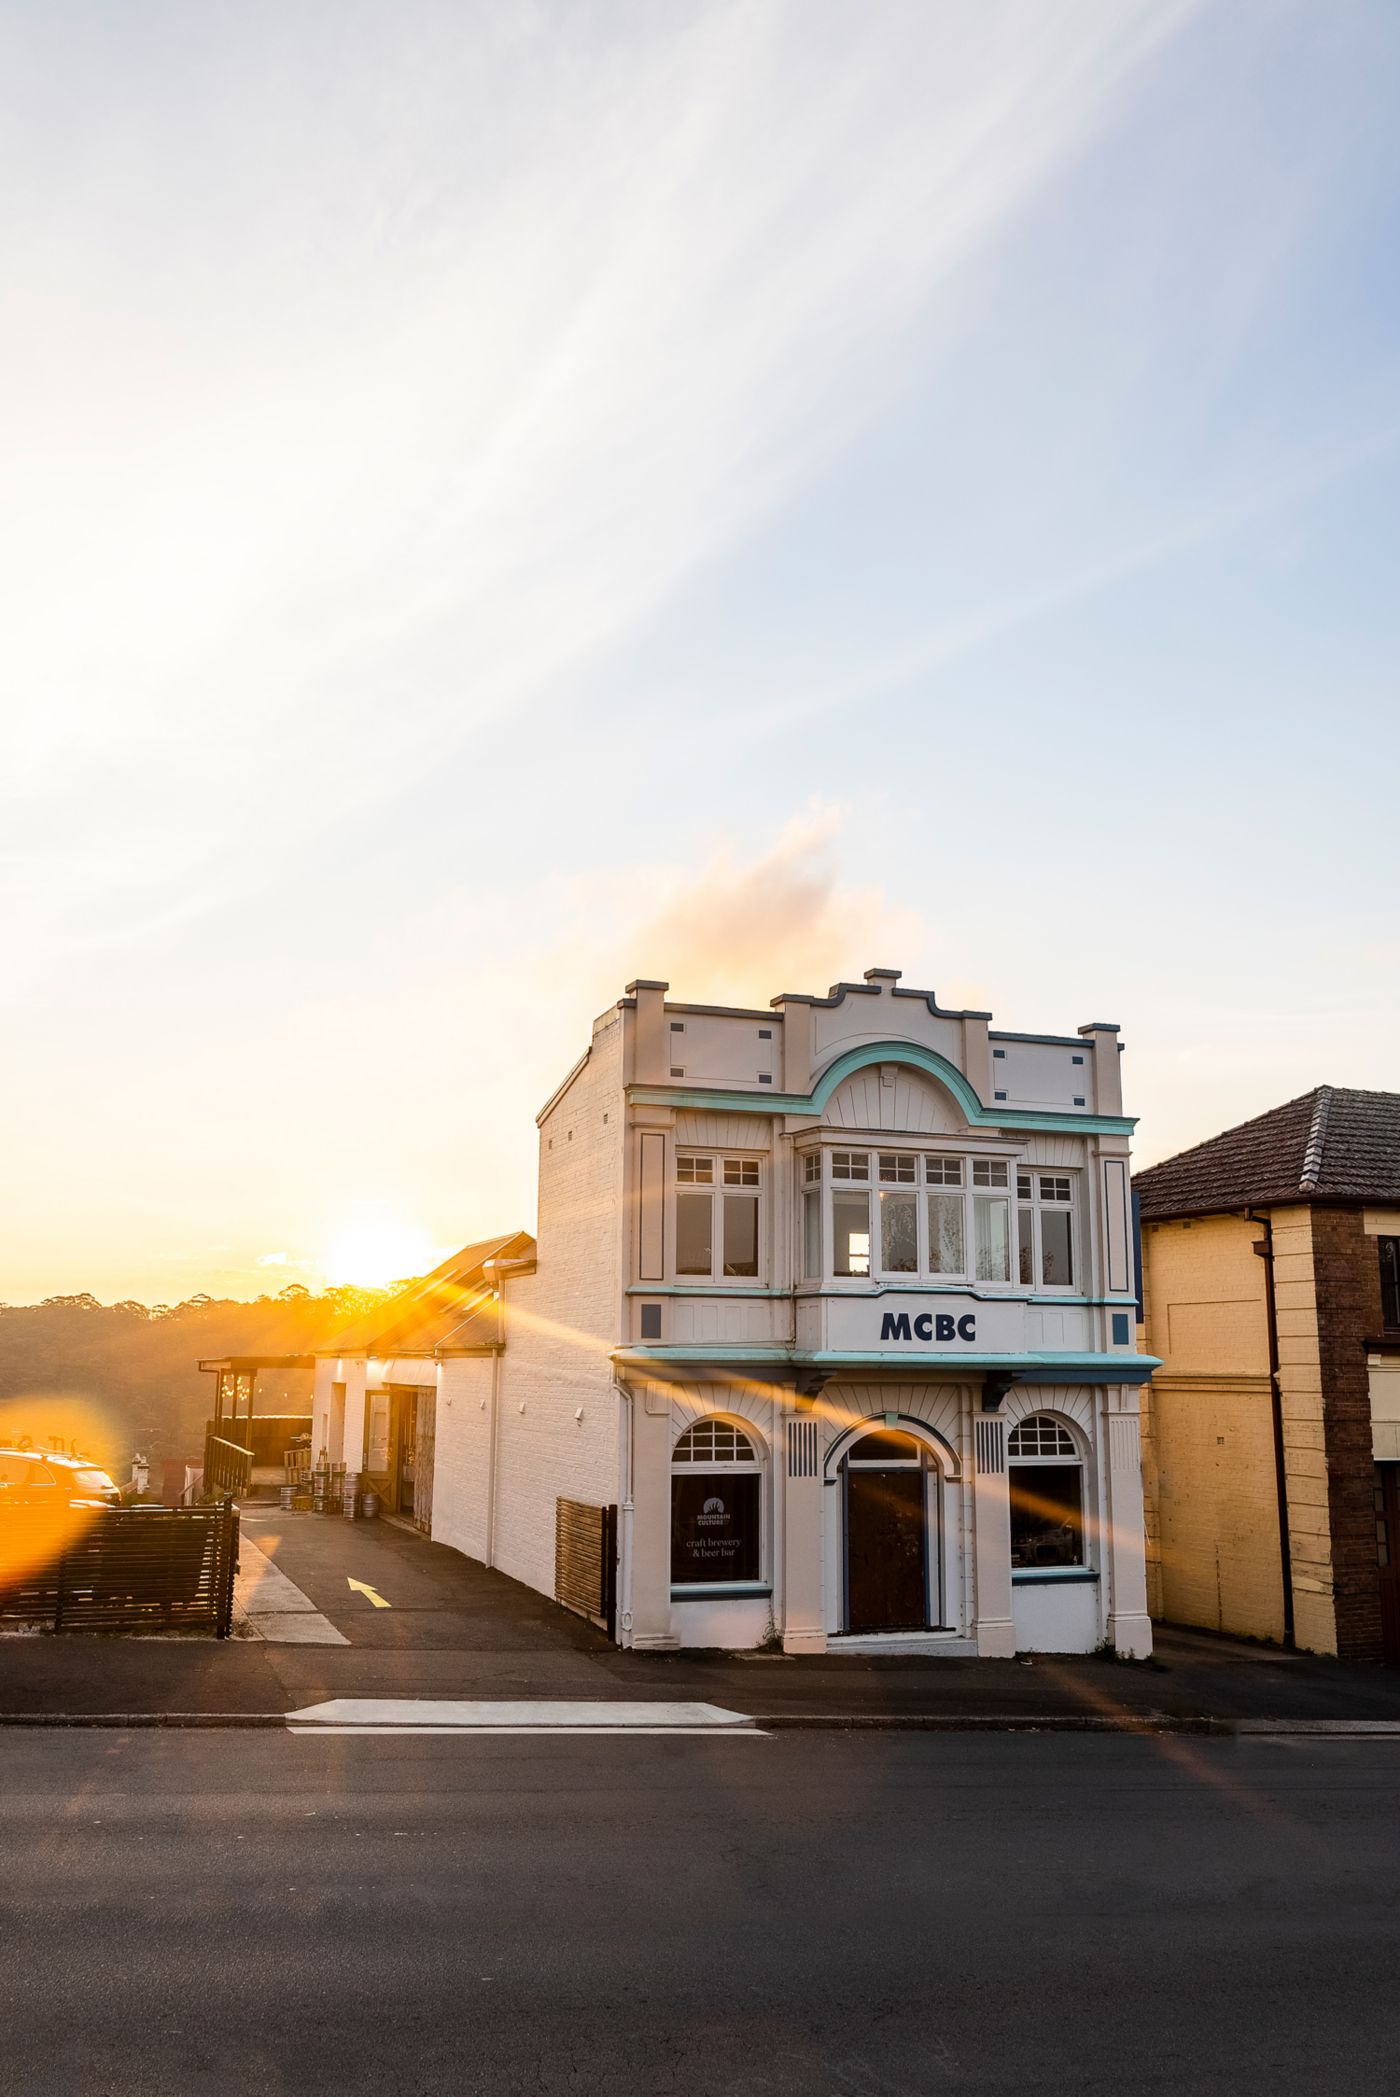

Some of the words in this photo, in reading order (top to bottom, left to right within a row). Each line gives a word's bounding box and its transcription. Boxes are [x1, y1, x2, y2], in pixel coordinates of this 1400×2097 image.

[880, 1313, 976, 1341] MCBC
[686, 1538, 706, 1548] craft
[707, 1538, 741, 1548] brewery
[692, 1549, 700, 1557] &
[701, 1549, 720, 1557] beer
[721, 1548, 735, 1557] bar
